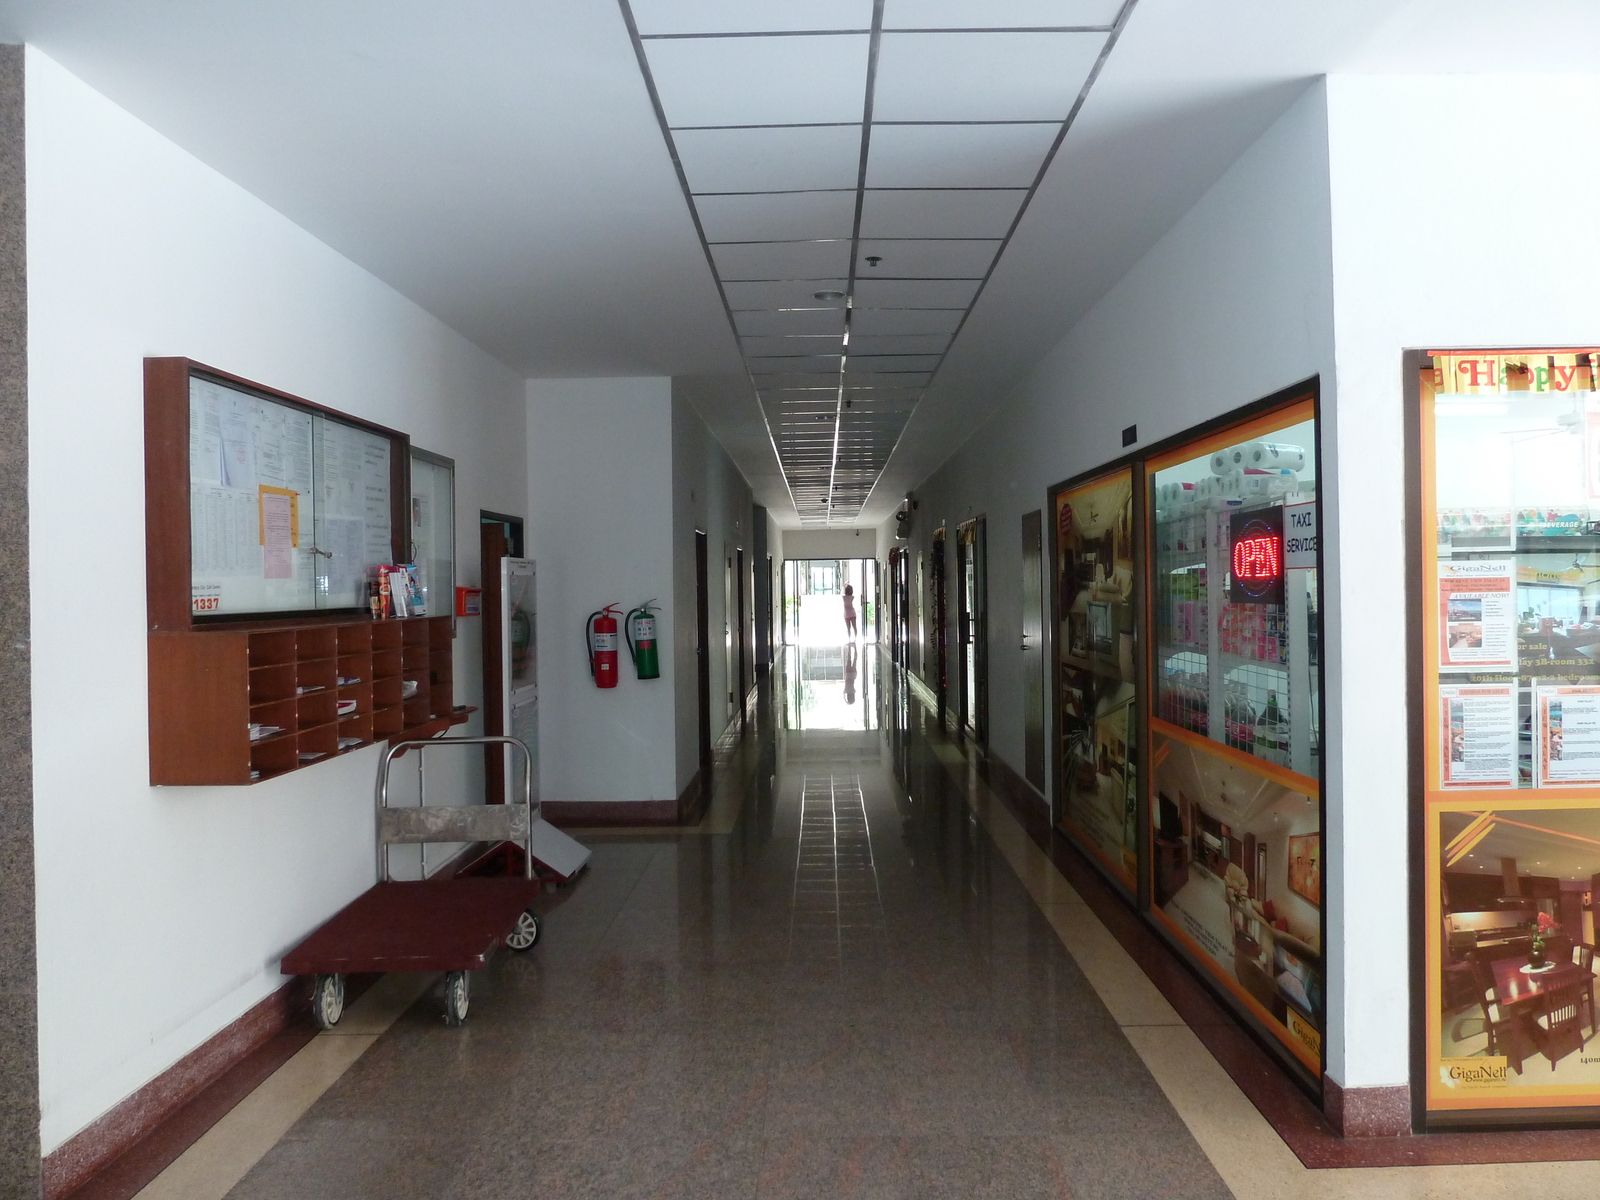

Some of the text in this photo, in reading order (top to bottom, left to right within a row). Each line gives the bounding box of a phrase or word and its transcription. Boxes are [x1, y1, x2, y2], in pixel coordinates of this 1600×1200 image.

[1291, 512, 1311, 528] TAXI
[1287, 538, 1317, 553] SERVICE
[1233, 537, 1278, 578] OPEN
[193, 597, 219, 610] 1337
[1529, 642, 1547, 650] sale
[1577, 658, 1595, 666] 332
[1292, 1020, 1321, 1053] GigaN
[1449, 1065, 1507, 1082] GigaNell
